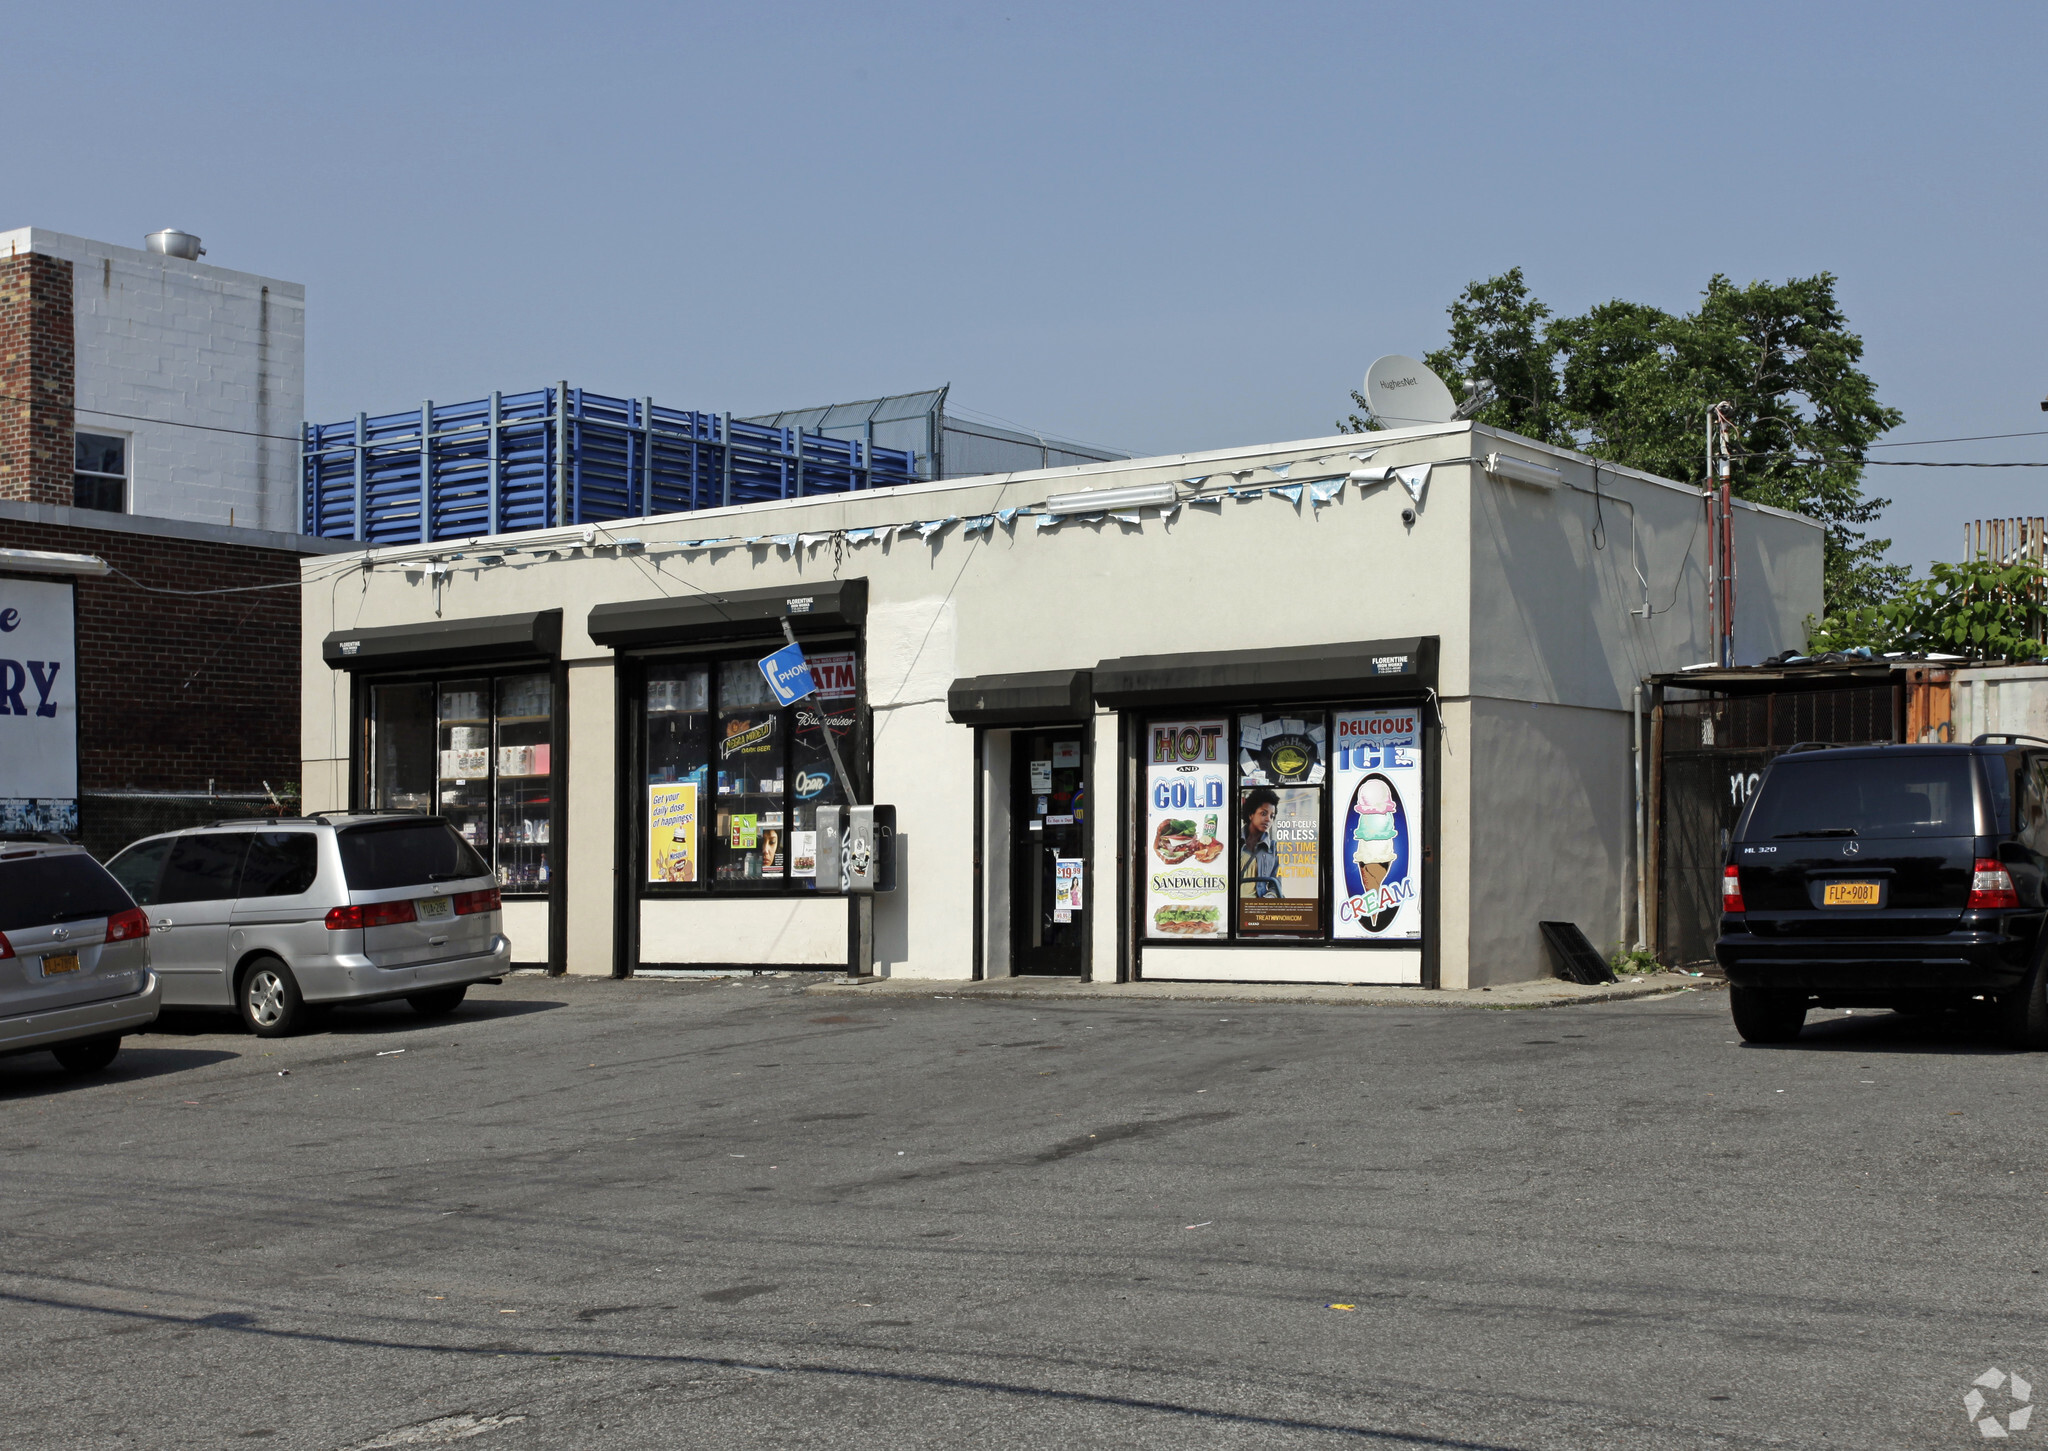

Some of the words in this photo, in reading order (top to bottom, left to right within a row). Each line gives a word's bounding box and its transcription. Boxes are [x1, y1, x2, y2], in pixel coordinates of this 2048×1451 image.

[1380, 377, 1418, 390] HughesNet
[1372, 656, 1408, 664] FLORENTINE
[810, 664, 855, 689] ATM
[0, 658, 60, 718] RY
[1340, 718, 1413, 736] DELICIOUS
[1153, 725, 1223, 762] HOT
[1267, 737, 1290, 753] Boar's
[1290, 737, 1311, 753] Head
[1340, 737, 1413, 770] ICE
[796, 771, 824, 796] Open
[653, 795, 665, 805] Get
[665, 792, 680, 804] your
[1154, 777, 1223, 808] COLD
[653, 805, 668, 817] daily
[669, 803, 685, 813] dose
[653, 818, 661, 828] of
[661, 813, 694, 827] happiness.
[1277, 821, 1290, 829] 500
[1276, 829, 1290, 840] OR
[1292, 829, 1317, 840] LESS.
[1276, 842, 1293, 852] IT'S
[1295, 841, 1317, 852] TIME
[1277, 853, 1290, 865] TO
[1292, 853, 1317, 865] TAKE
[1057, 867, 1081, 879] $19.99
[1276, 866, 1316, 878] ACTION.
[1153, 875, 1226, 891] SANDWICHES
[1341, 879, 1414, 921] CREAM
[1829, 886, 1873, 900] FLP-9081
